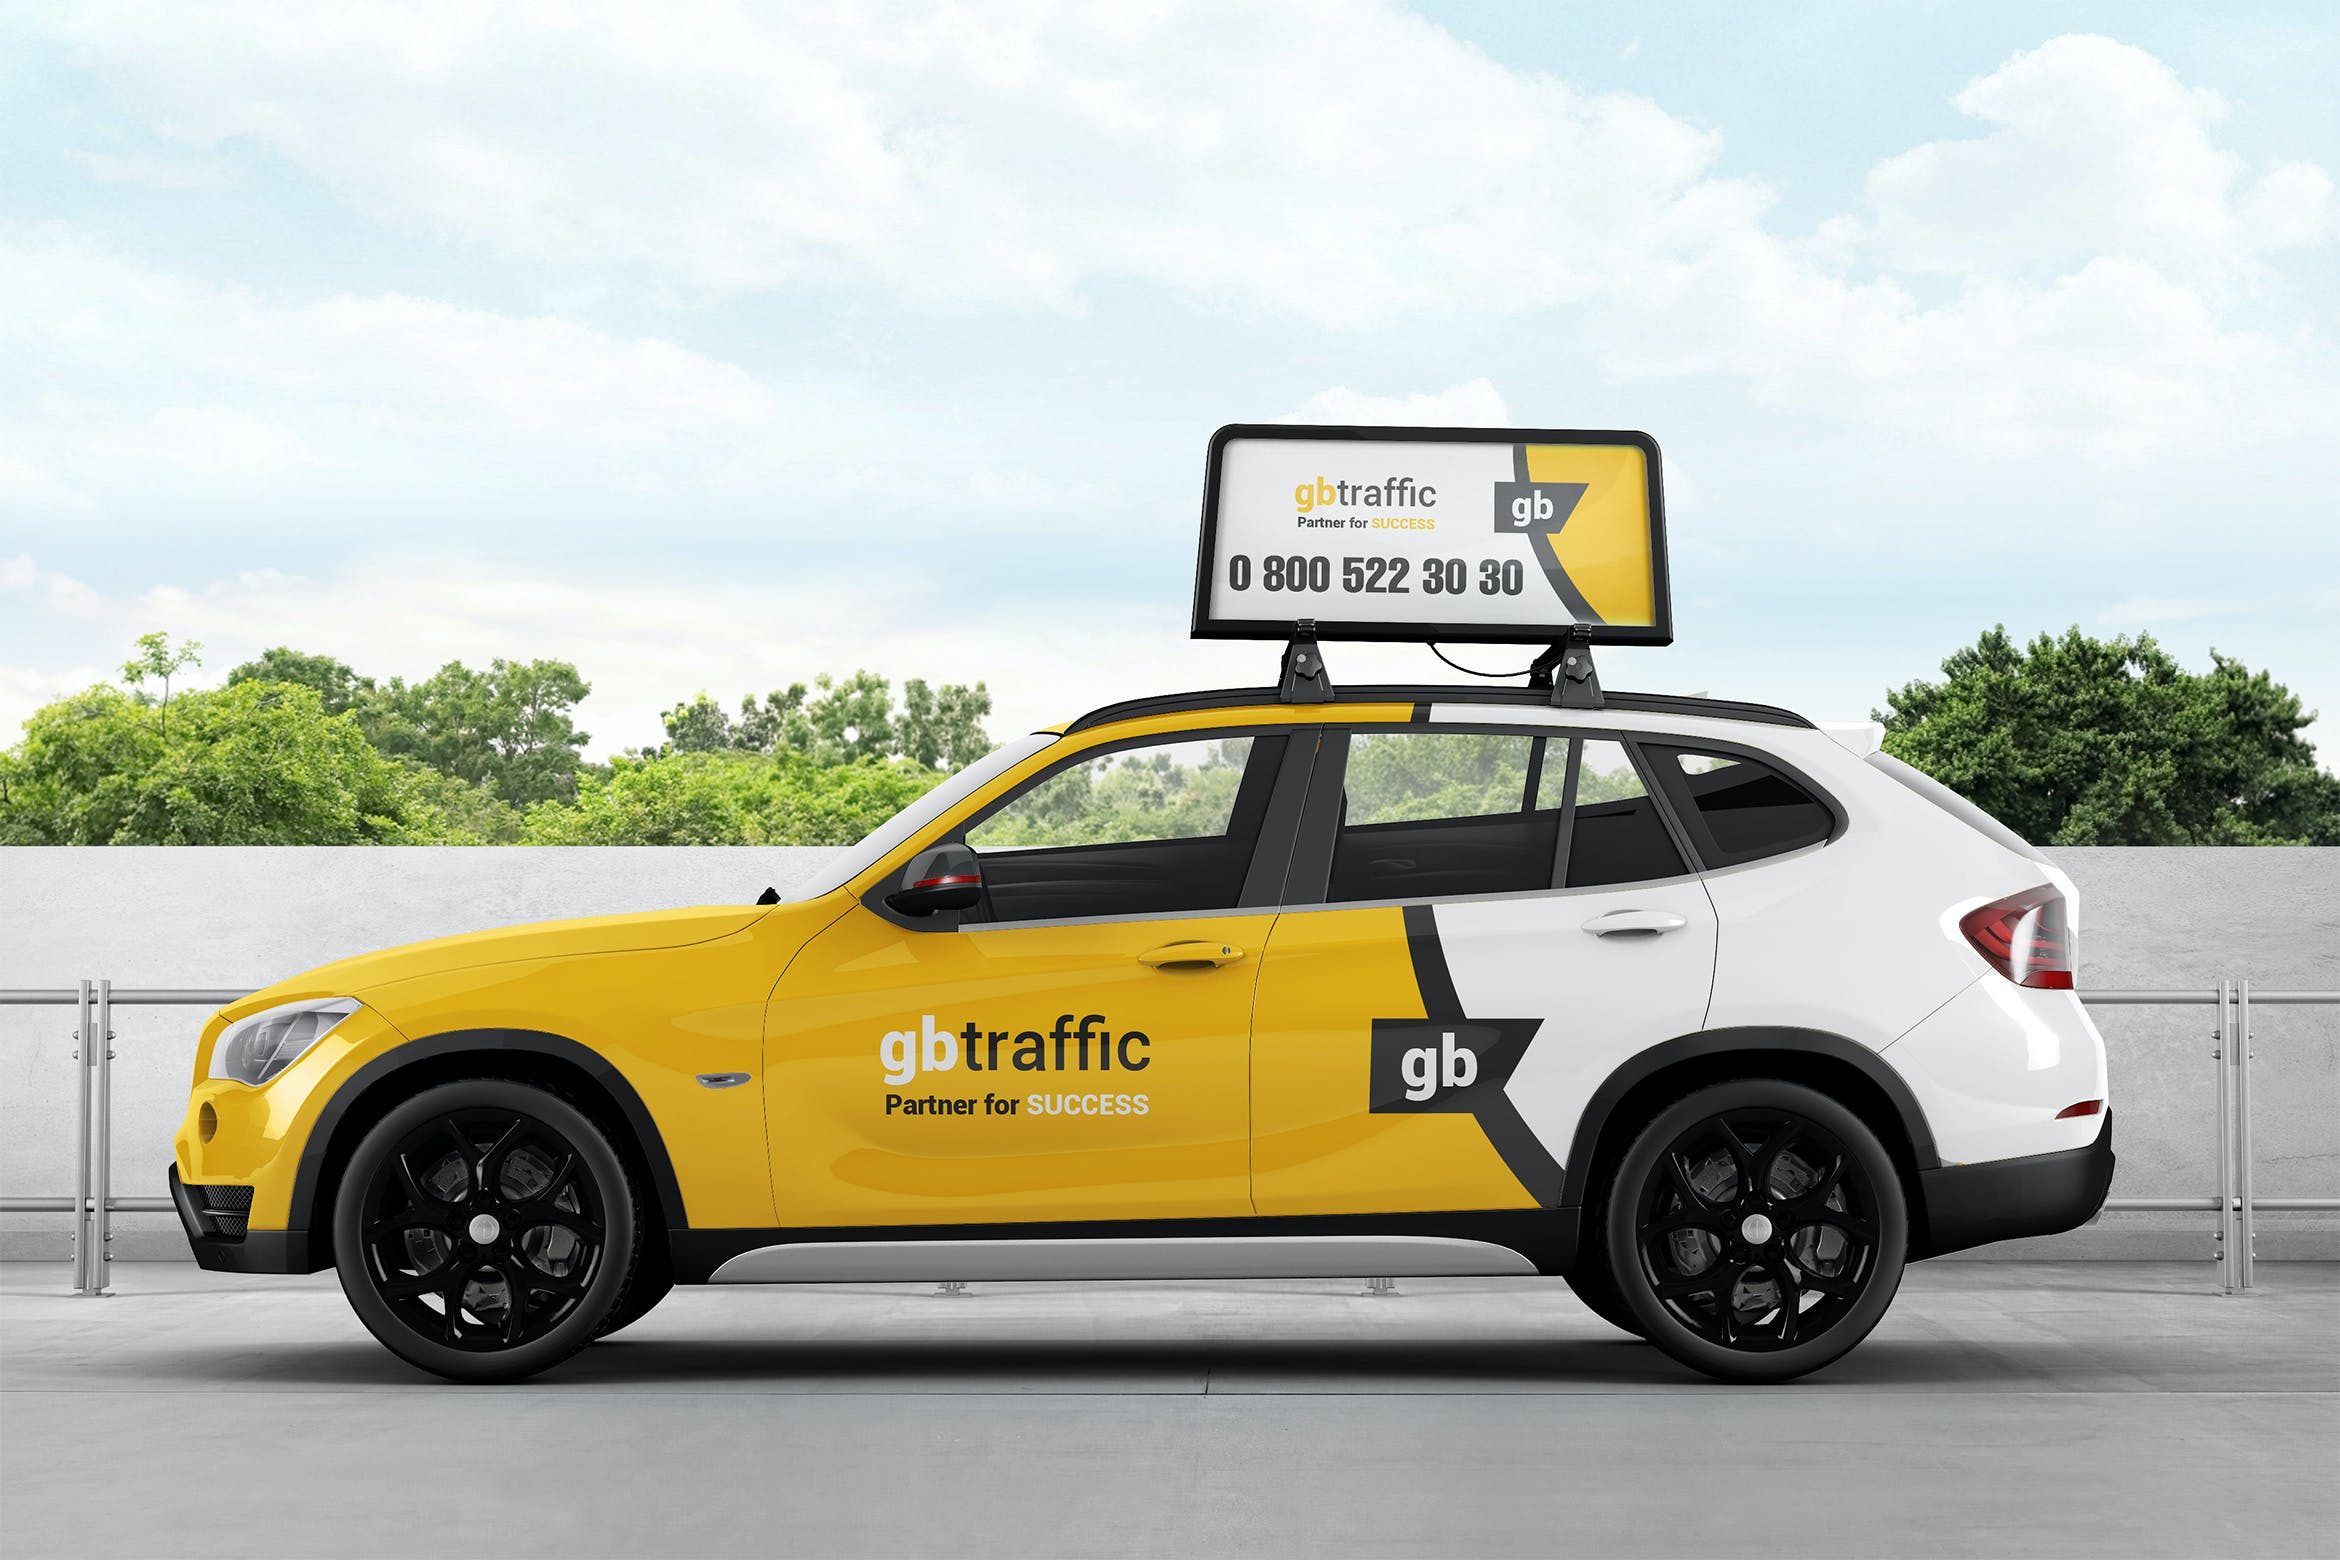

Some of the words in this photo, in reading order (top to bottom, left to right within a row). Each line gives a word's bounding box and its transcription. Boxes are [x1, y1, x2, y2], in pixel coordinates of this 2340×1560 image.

[1294, 476, 1436, 512] gbtraffic
[1511, 490, 1554, 527] gb
[1297, 516, 1346, 528] Partner
[1348, 516, 1369, 528] for
[1371, 517, 1435, 529] SUCCESS
[1228, 554, 1252, 591] 0
[1263, 554, 1331, 592] 800
[1342, 556, 1410, 594] 522
[1422, 557, 1467, 596] 30
[1478, 558, 1524, 597] 30
[879, 1013, 1151, 1086] gbtraffic
[1401, 1032, 1478, 1102] gb
[885, 1093, 978, 1116] Partner
[984, 1092, 1021, 1116] for
[1026, 1093, 1150, 1116] SUCCESS
